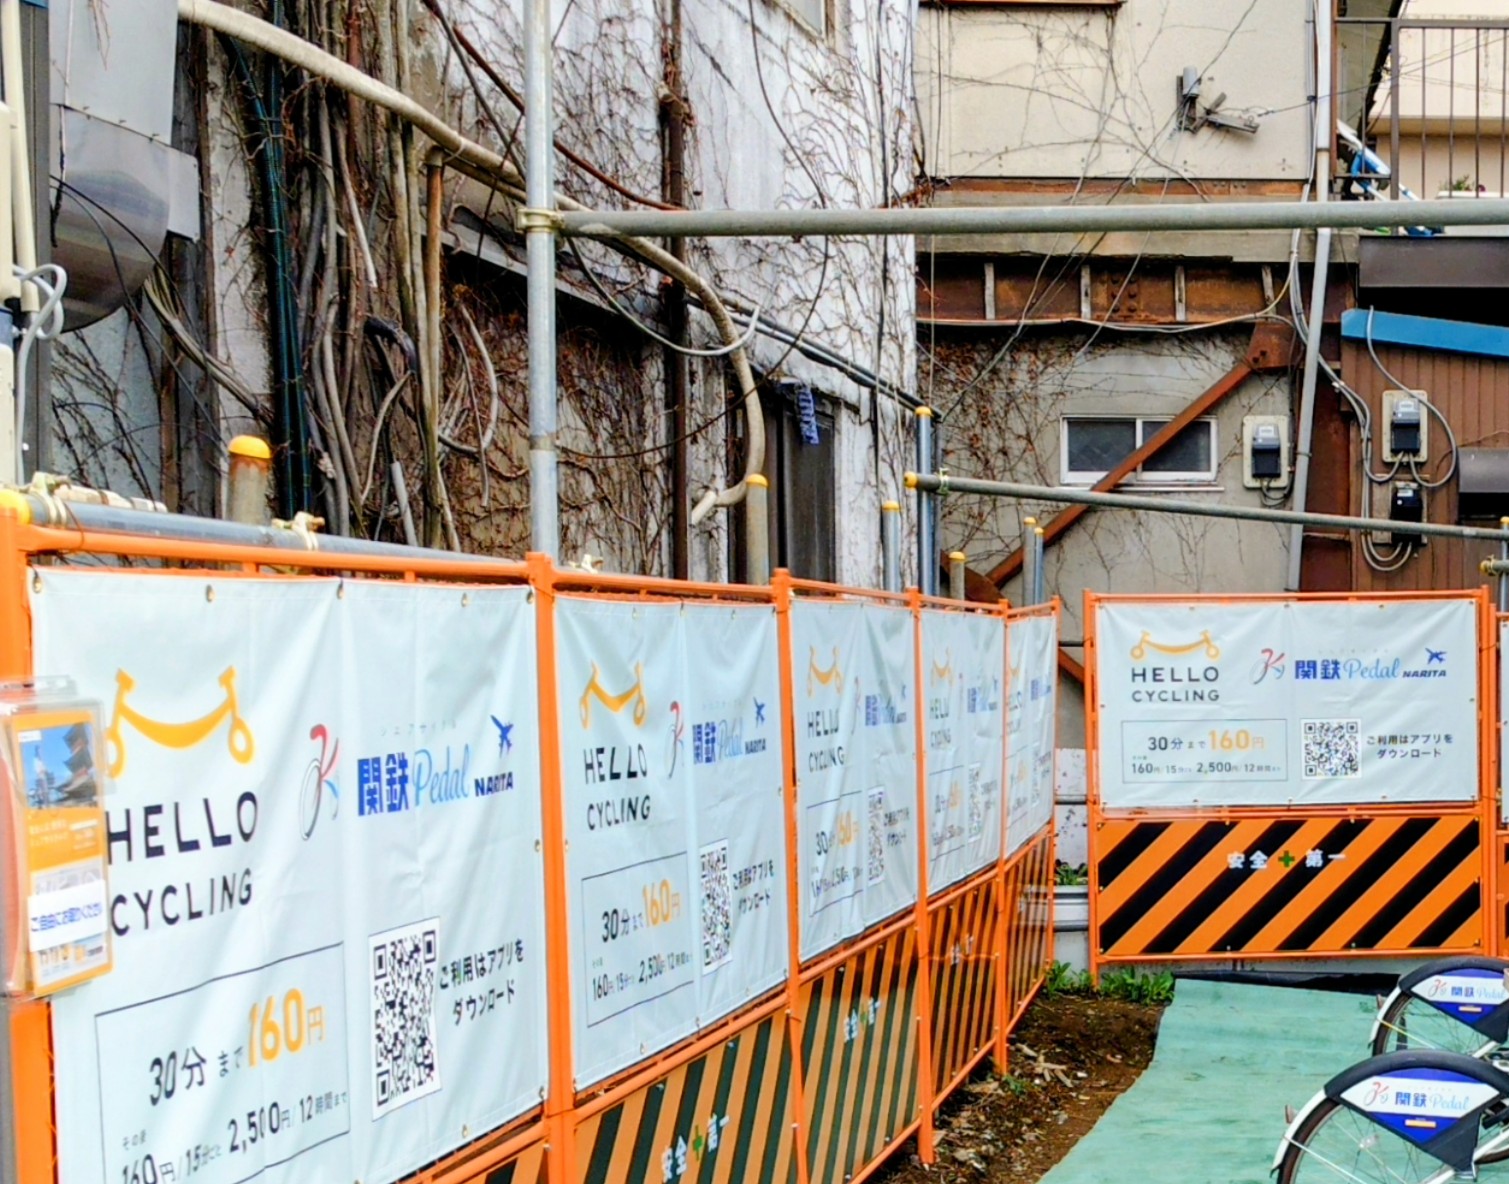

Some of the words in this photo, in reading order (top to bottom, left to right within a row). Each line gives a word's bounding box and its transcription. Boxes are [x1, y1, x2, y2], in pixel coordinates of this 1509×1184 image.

[1131, 666, 1219, 683] HELLO
[1402, 669, 1447, 678] NARITA
[1131, 689, 1220, 703] CYCLING
[1366, 734, 1453, 746] ご利用はアプリを
[583, 743, 648, 785] HELLO
[1377, 748, 1442, 759] ダウンロード
[474, 771, 513, 797] NARITA
[587, 795, 651, 831] CYCLING
[106, 790, 258, 865] HELLO
[1227, 851, 1268, 869] 安全
[1305, 848, 1347, 868] 第一
[110, 867, 254, 937] CYCLING
[439, 937, 525, 991] ご利用はアプリを
[452, 979, 517, 1026] ダウンロード
